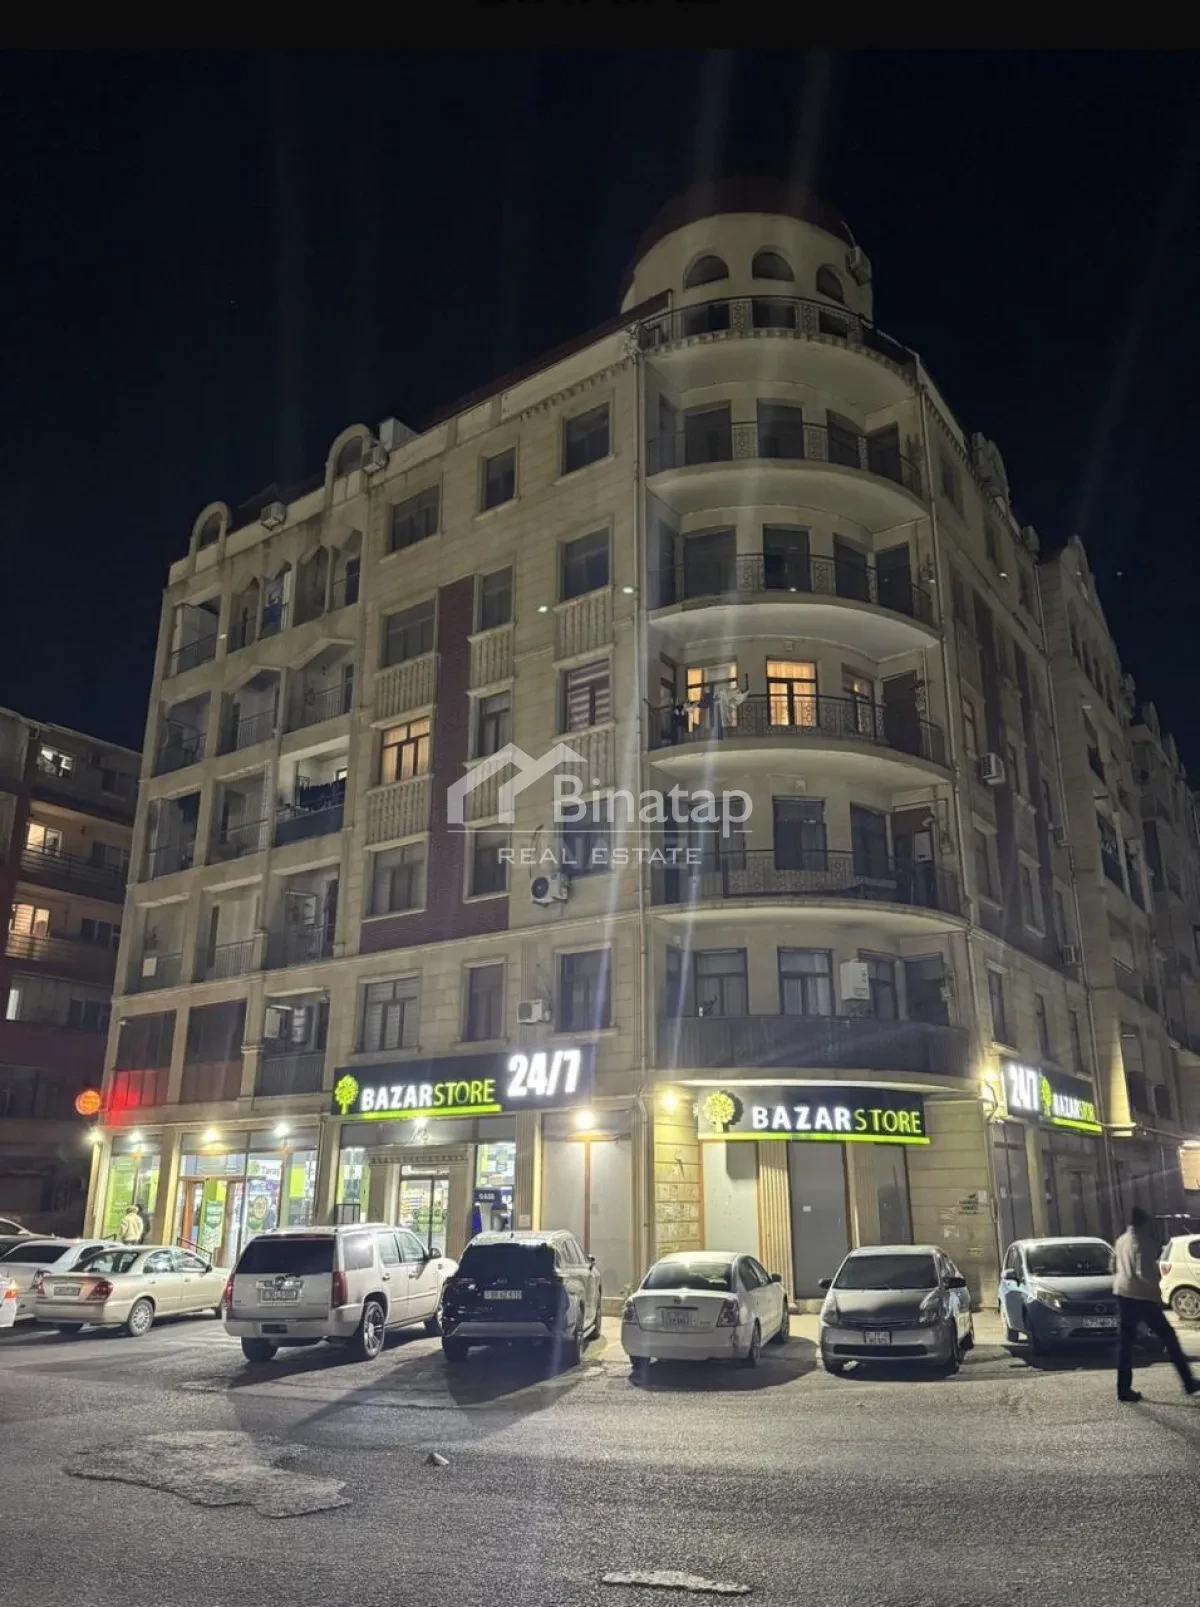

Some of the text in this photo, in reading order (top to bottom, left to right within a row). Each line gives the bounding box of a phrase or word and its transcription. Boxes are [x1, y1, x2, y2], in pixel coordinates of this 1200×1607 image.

[360, 1049, 581, 1112] BAZARSTORE 24/7
[752, 1105, 922, 1134] BAZARSTORE
